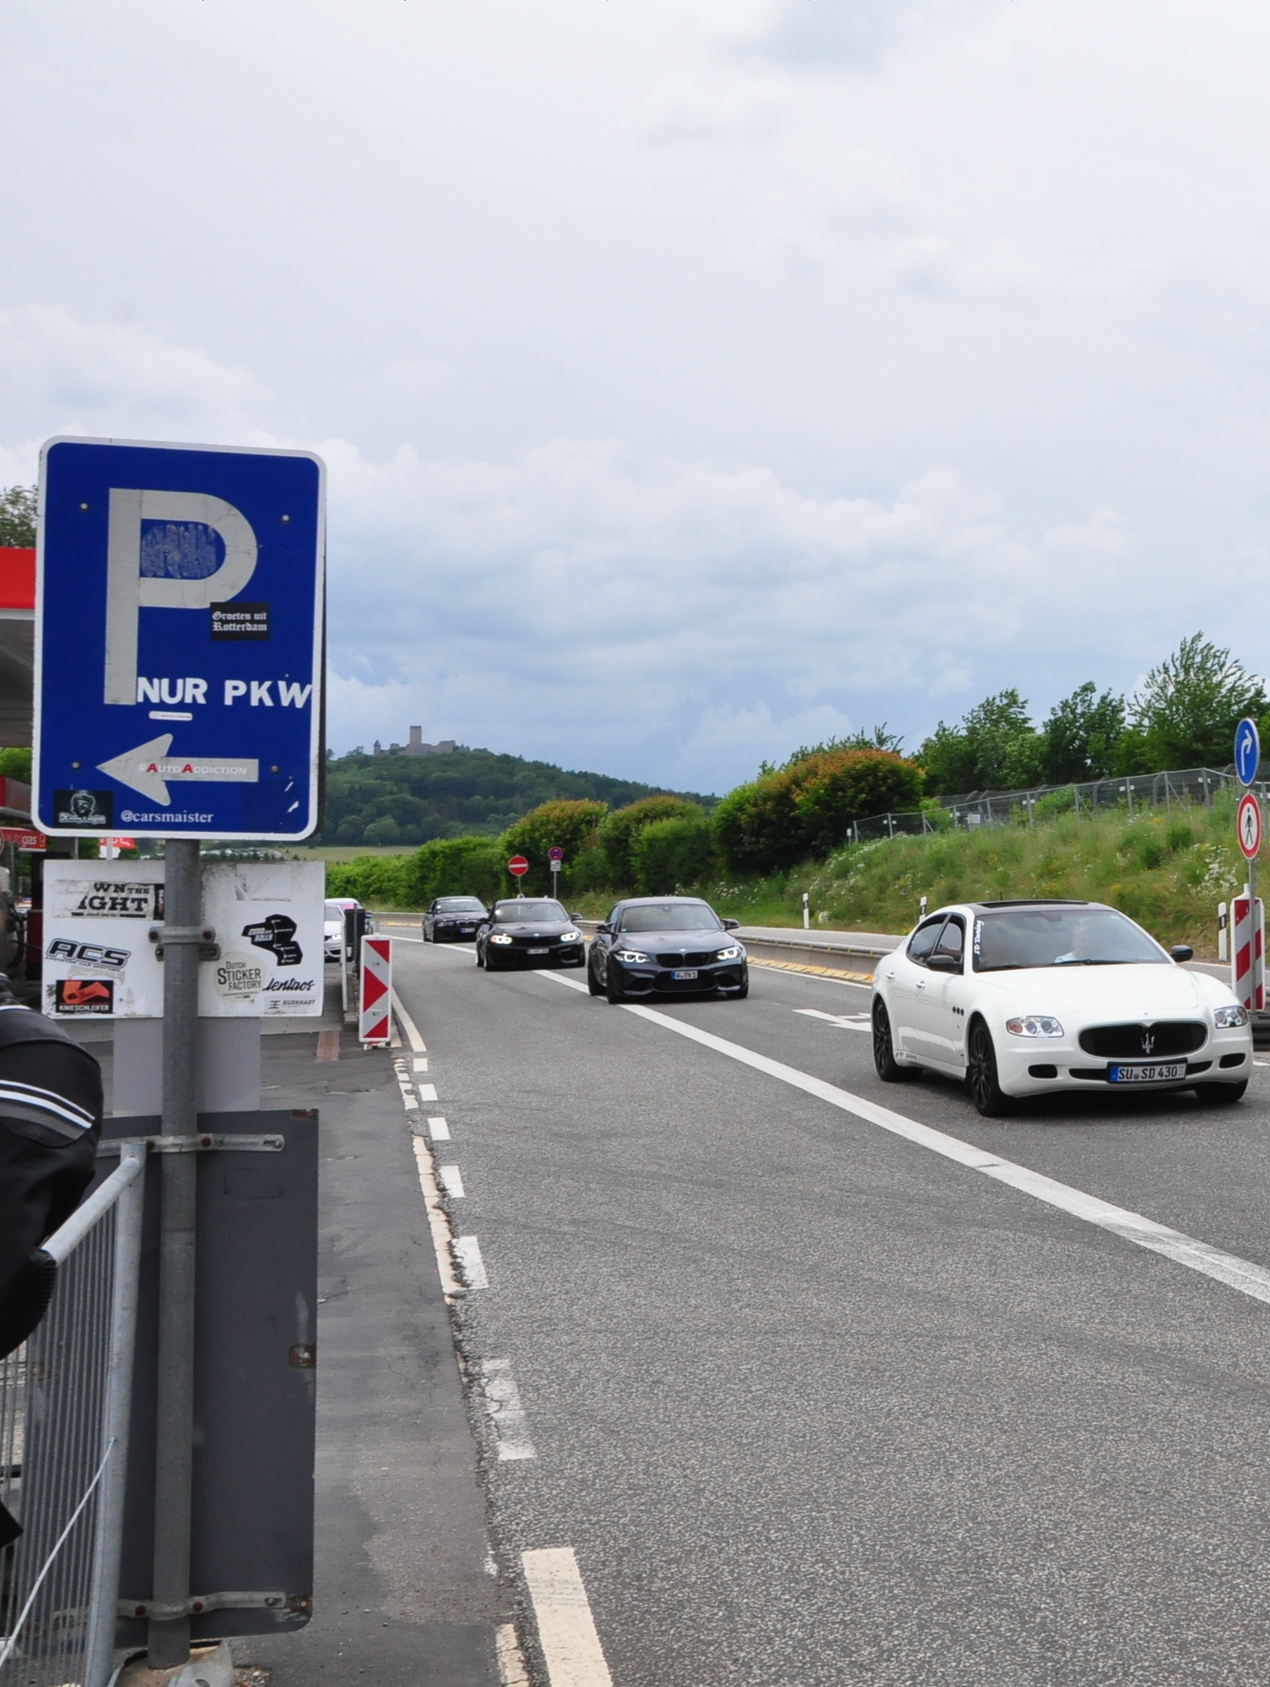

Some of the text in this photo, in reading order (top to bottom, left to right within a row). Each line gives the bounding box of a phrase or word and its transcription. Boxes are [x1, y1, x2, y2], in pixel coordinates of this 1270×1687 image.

[105, 488, 258, 705] P
[212, 611, 267, 620] Groeten uit
[212, 621, 268, 631] Rotterdam
[137, 677, 313, 709] NUR PKW
[121, 810, 214, 823] @carsmaister
[46, 938, 131, 969] ACS
[228, 980, 261, 991] FACTORY
[1118, 1068, 1133, 1080] SU
[1141, 1067, 1156, 1079] SD
[1158, 1065, 1178, 1079] 430
